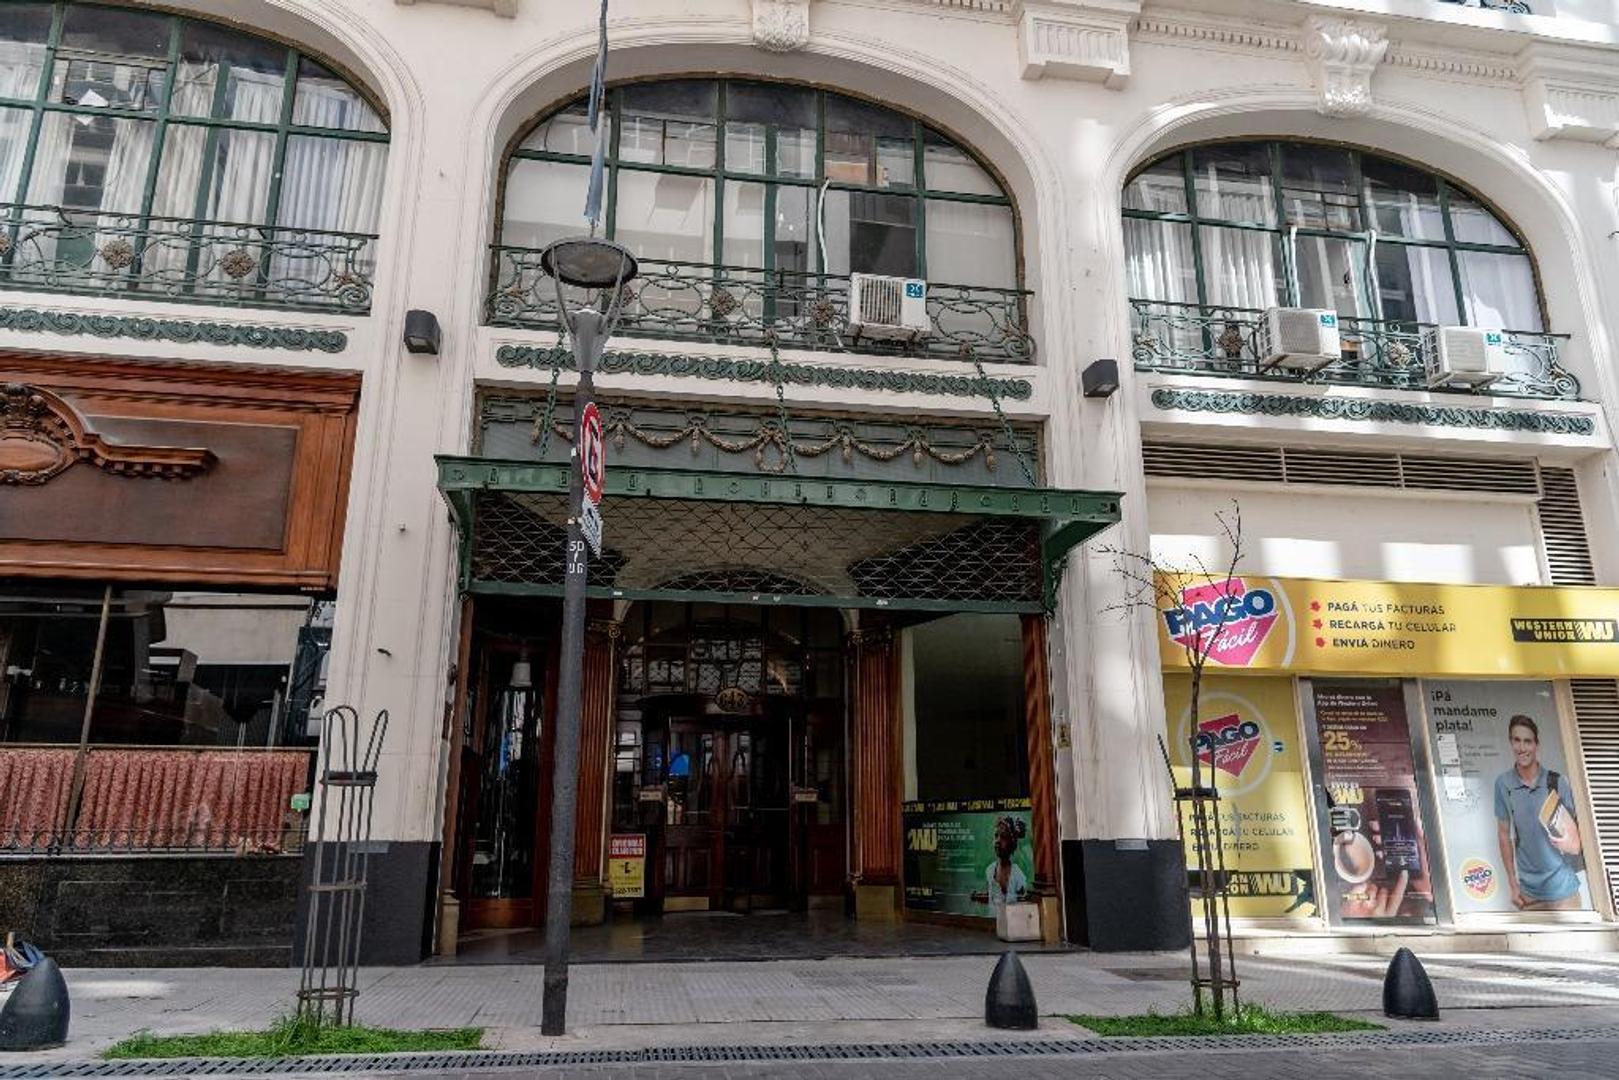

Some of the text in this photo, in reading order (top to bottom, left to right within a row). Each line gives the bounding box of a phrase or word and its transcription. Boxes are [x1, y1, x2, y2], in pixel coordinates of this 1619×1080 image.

[1163, 589, 1275, 637] PAGO
[1362, 603, 1383, 613] TUS
[1386, 604, 1445, 615] FACTURAS
[1388, 621, 1402, 630] TU
[1406, 623, 1456, 632] CELULAR
[1514, 621, 1574, 630] WESTERN
[1534, 631, 1575, 639] UNION
[1371, 639, 1415, 649] DINERO
[1434, 705, 1497, 717] mandame
[1436, 720, 1472, 732] plata!
